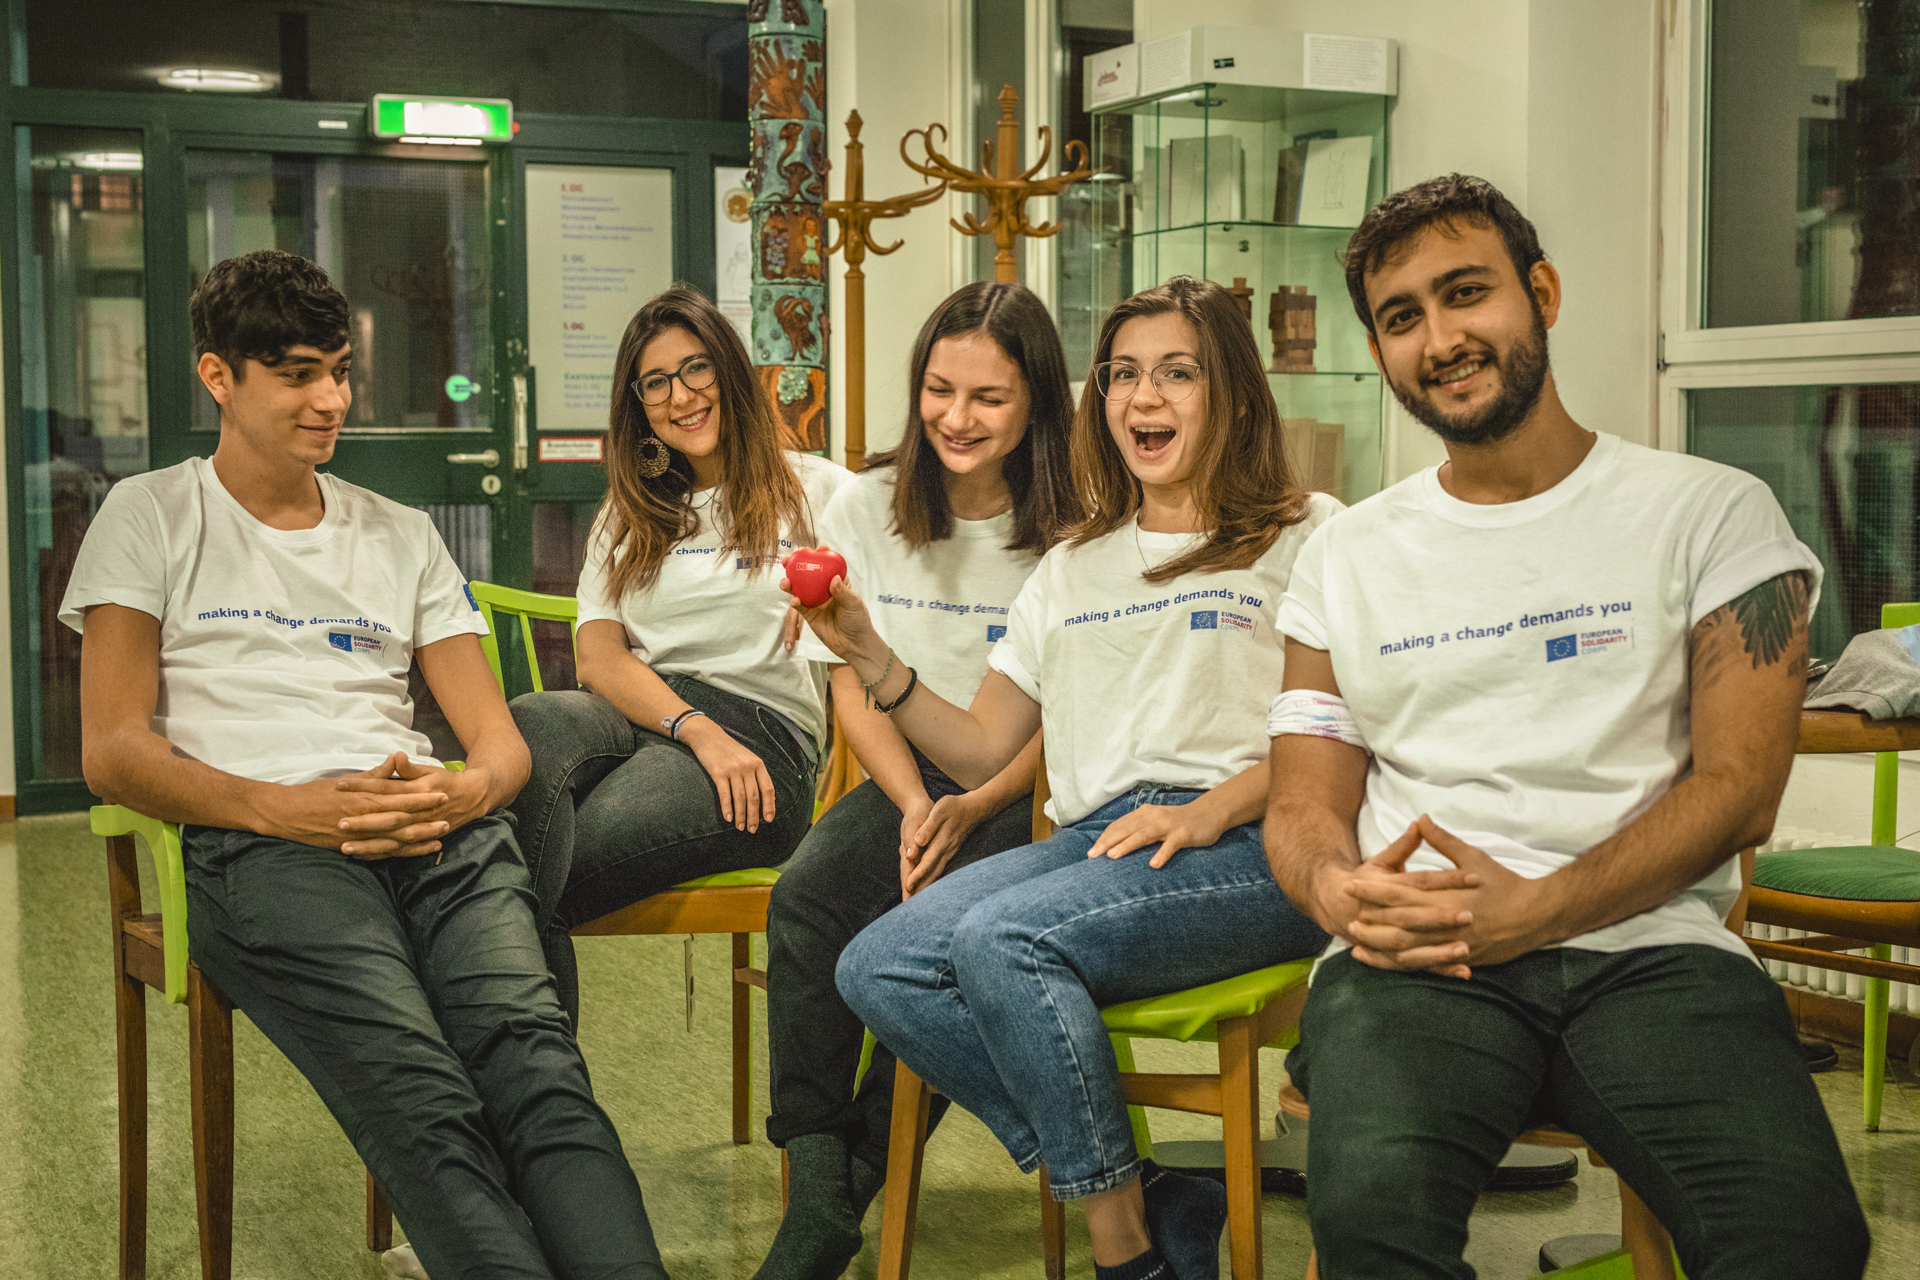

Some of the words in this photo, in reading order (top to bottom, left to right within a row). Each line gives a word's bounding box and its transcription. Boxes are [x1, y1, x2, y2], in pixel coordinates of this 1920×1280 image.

[676, 547, 717, 555] change
[777, 539, 792, 548] ou
[916, 600, 925, 608] a
[928, 600, 970, 615] change
[1064, 610, 1110, 628] making
[1113, 609, 1121, 618] a
[1125, 599, 1170, 616] change
[1174, 588, 1234, 604] demands
[1239, 593, 1263, 608] you
[198, 607, 249, 620] making
[253, 609, 262, 617] a
[265, 609, 305, 629] change
[309, 616, 369, 628] demands
[372, 620, 392, 633] you
[1221, 611, 1252, 623] EUROPEAN
[1220, 618, 1253, 631] SOLIDARITY
[1220, 624, 1240, 632] CORPS
[1380, 633, 1435, 656] making
[1440, 632, 1450, 643] a
[1456, 621, 1514, 640] change
[1519, 604, 1594, 628] demands
[1600, 601, 1632, 618] you
[353, 635, 382, 645] EUROPEAN
[1580, 628, 1623, 640] EUROPEAN
[353, 641, 382, 651] SOLIDARITY
[1580, 635, 1628, 647] SOLIDARITY
[1581, 646, 1608, 655] CORPS
